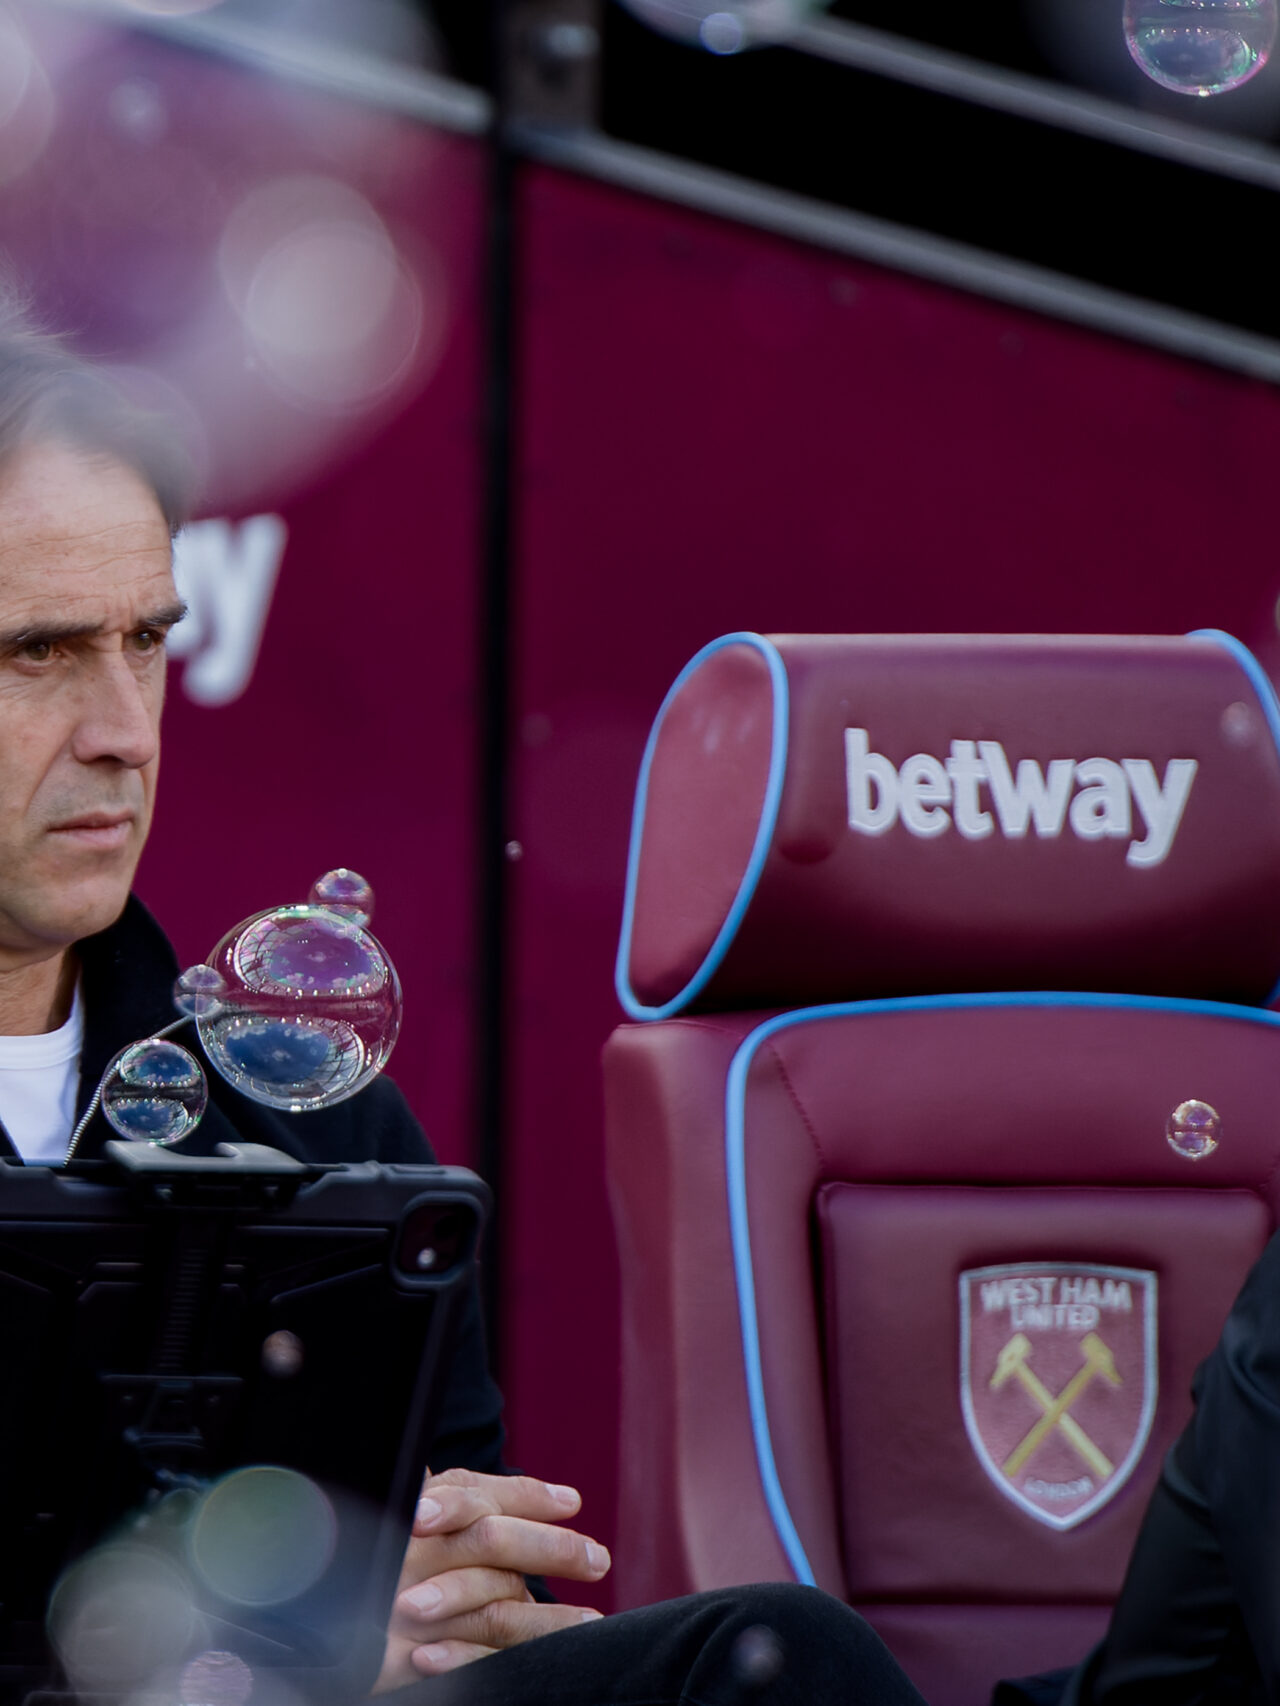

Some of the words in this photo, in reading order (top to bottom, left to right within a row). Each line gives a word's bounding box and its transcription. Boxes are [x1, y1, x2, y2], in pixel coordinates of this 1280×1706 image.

[844, 727, 1198, 868] betway
[980, 1276, 1056, 1312] WEST
[1060, 1277, 1133, 1312] HAM
